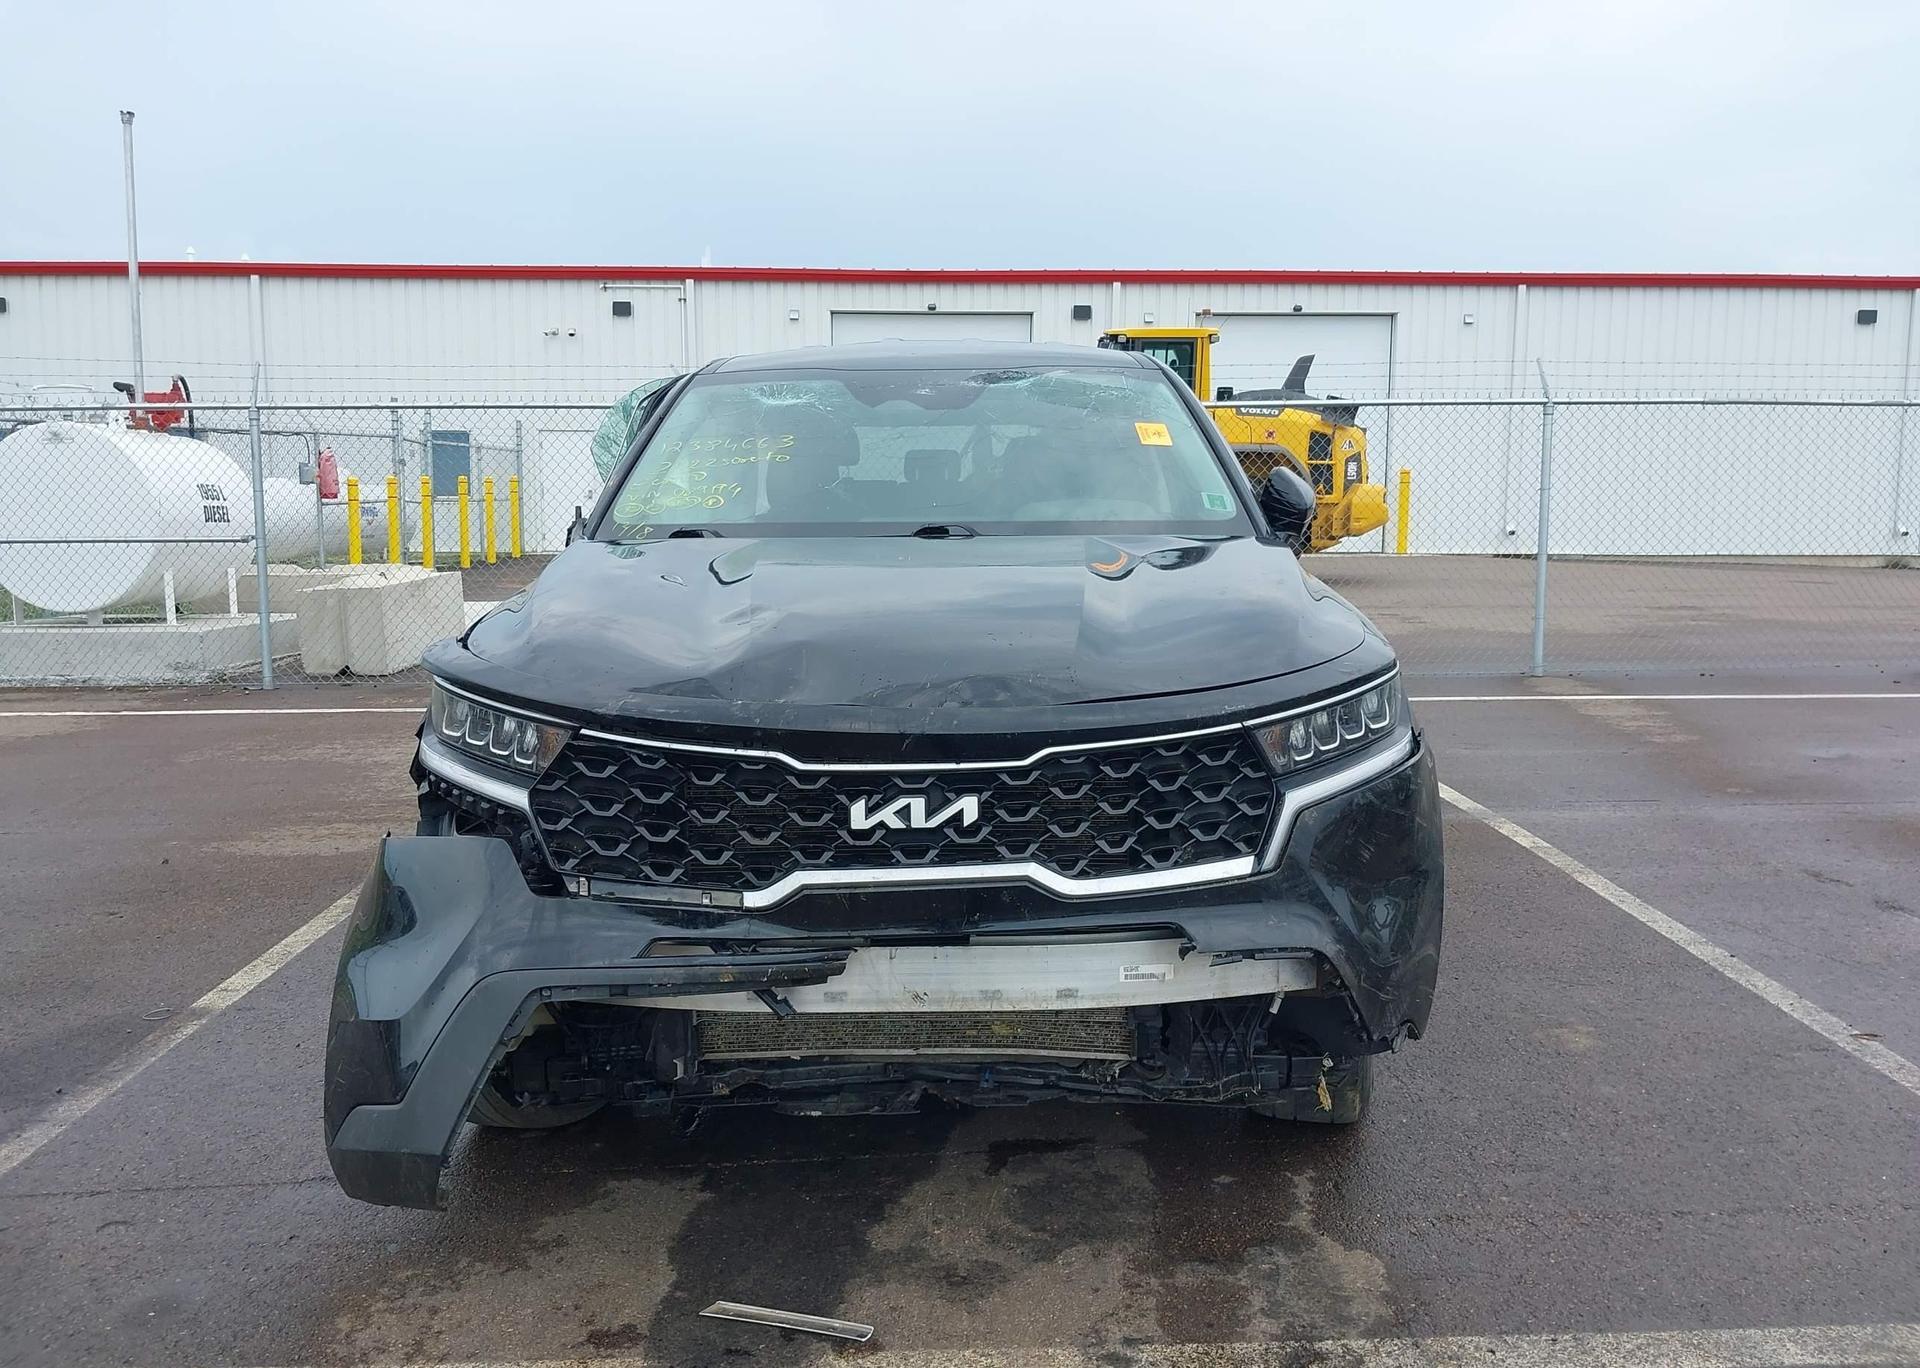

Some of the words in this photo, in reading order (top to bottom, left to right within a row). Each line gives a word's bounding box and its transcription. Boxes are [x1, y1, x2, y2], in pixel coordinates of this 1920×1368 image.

[1240, 407, 1279, 415] VOLVO
[196, 483, 220, 501] 1955
[203, 505, 230, 523] DIESEL
[850, 796, 979, 829] KIA
